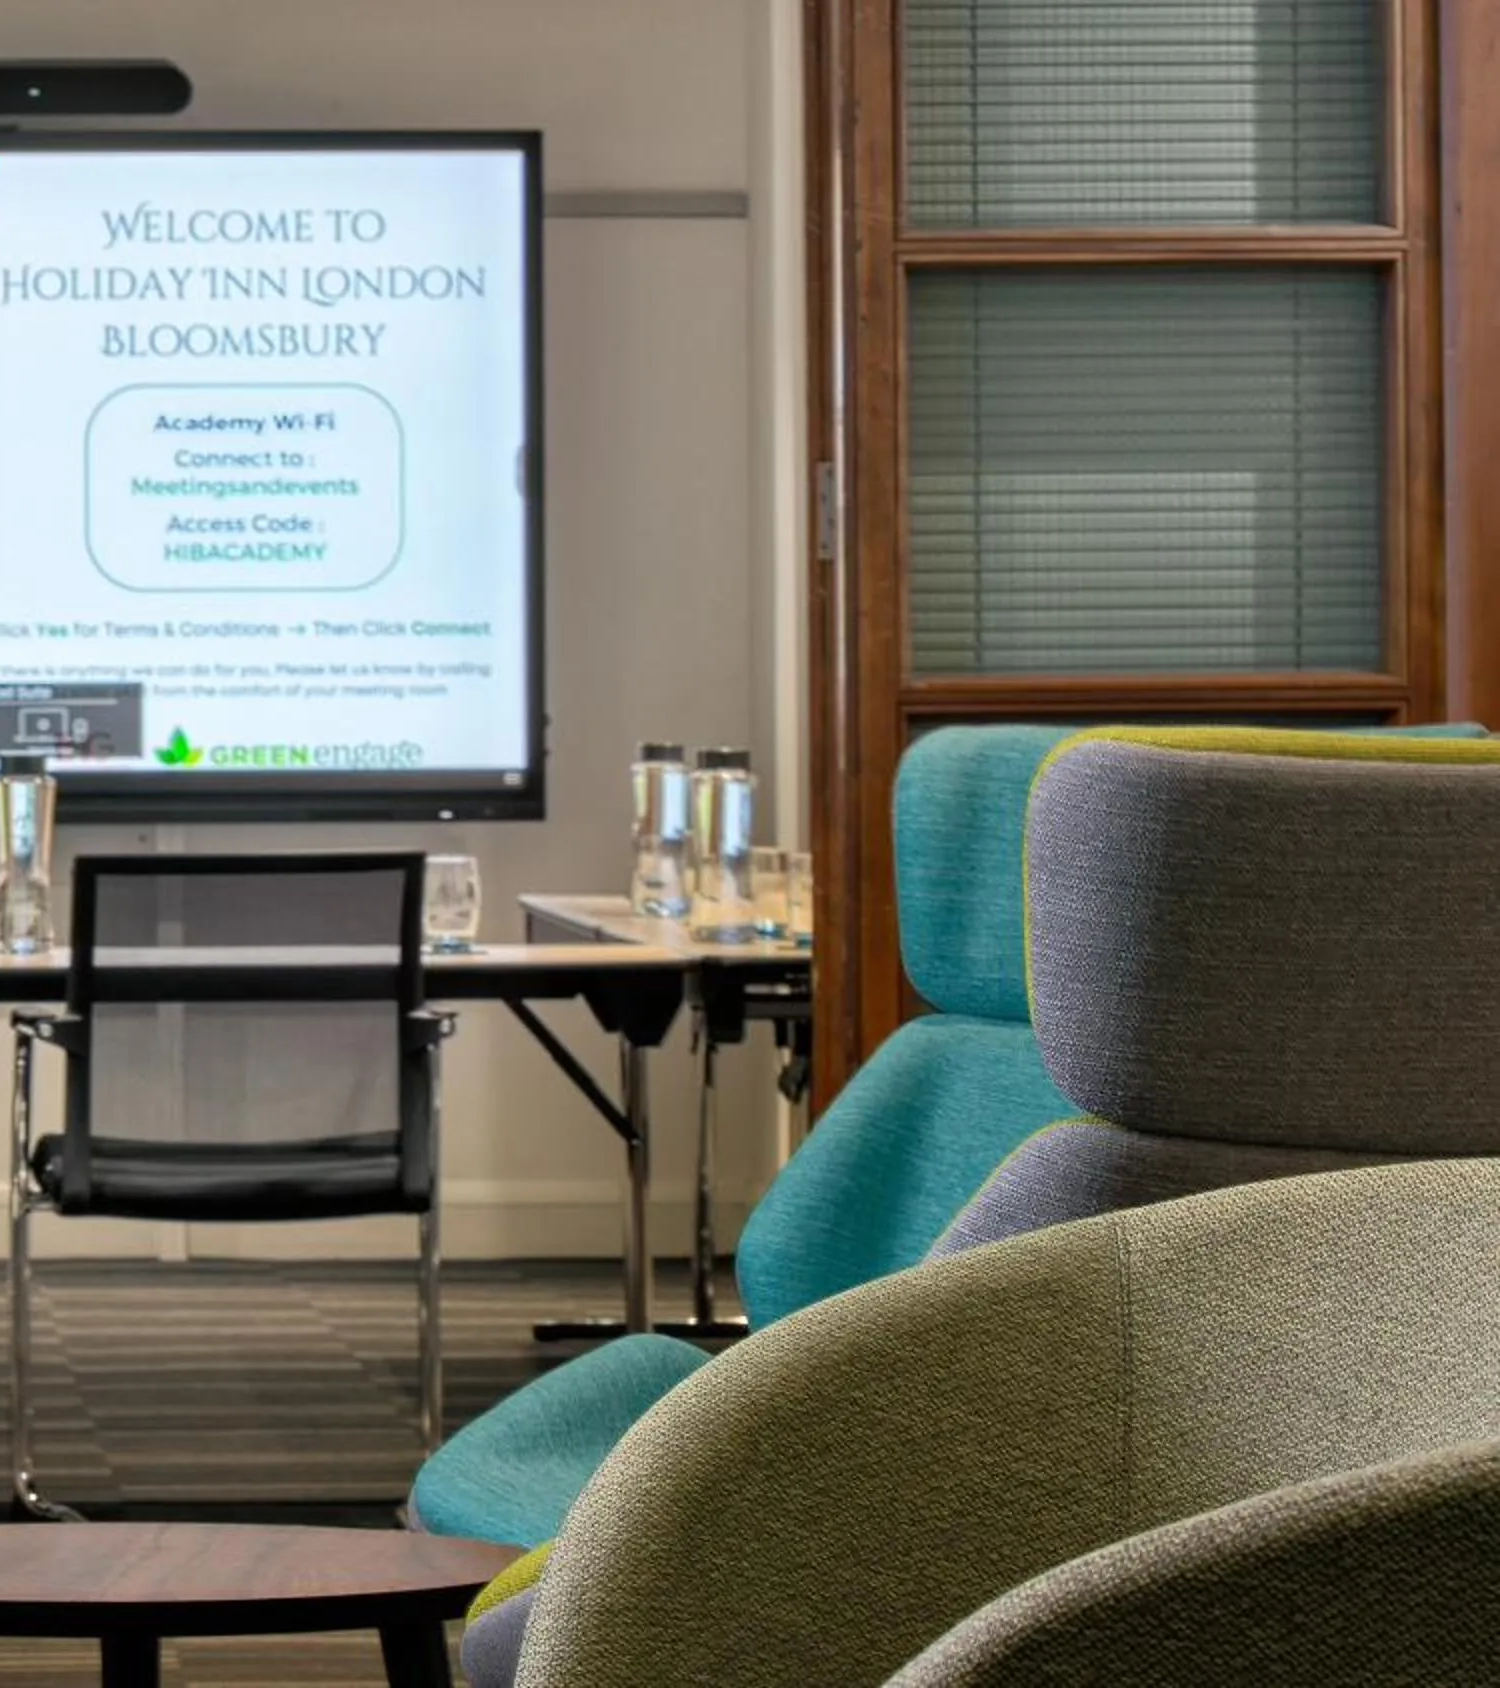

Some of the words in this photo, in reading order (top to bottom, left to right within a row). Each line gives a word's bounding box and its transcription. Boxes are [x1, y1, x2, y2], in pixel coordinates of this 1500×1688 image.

[101, 202, 313, 250] WELCOME
[325, 208, 386, 244] TO
[1, 265, 193, 305] HOLIDAY
[202, 266, 287, 300] INN
[302, 264, 489, 307] LONDON
[100, 322, 386, 357] BLOOMSBURY
[153, 411, 267, 434] Academy
[174, 449, 274, 468] Connect
[131, 477, 360, 499] Meetingsandevents
[166, 514, 247, 533] Access
[252, 513, 314, 533] Code
[164, 543, 327, 562] HIBACADEMY
[36, 622, 69, 638] Yes
[74, 622, 99, 638] for
[104, 622, 159, 638] Terms
[179, 621, 280, 638] Conditions
[313, 621, 358, 636] Then
[362, 621, 406, 636] Click
[411, 621, 491, 636] Connect
[210, 744, 308, 766] GREEN
[313, 740, 423, 770] engage
